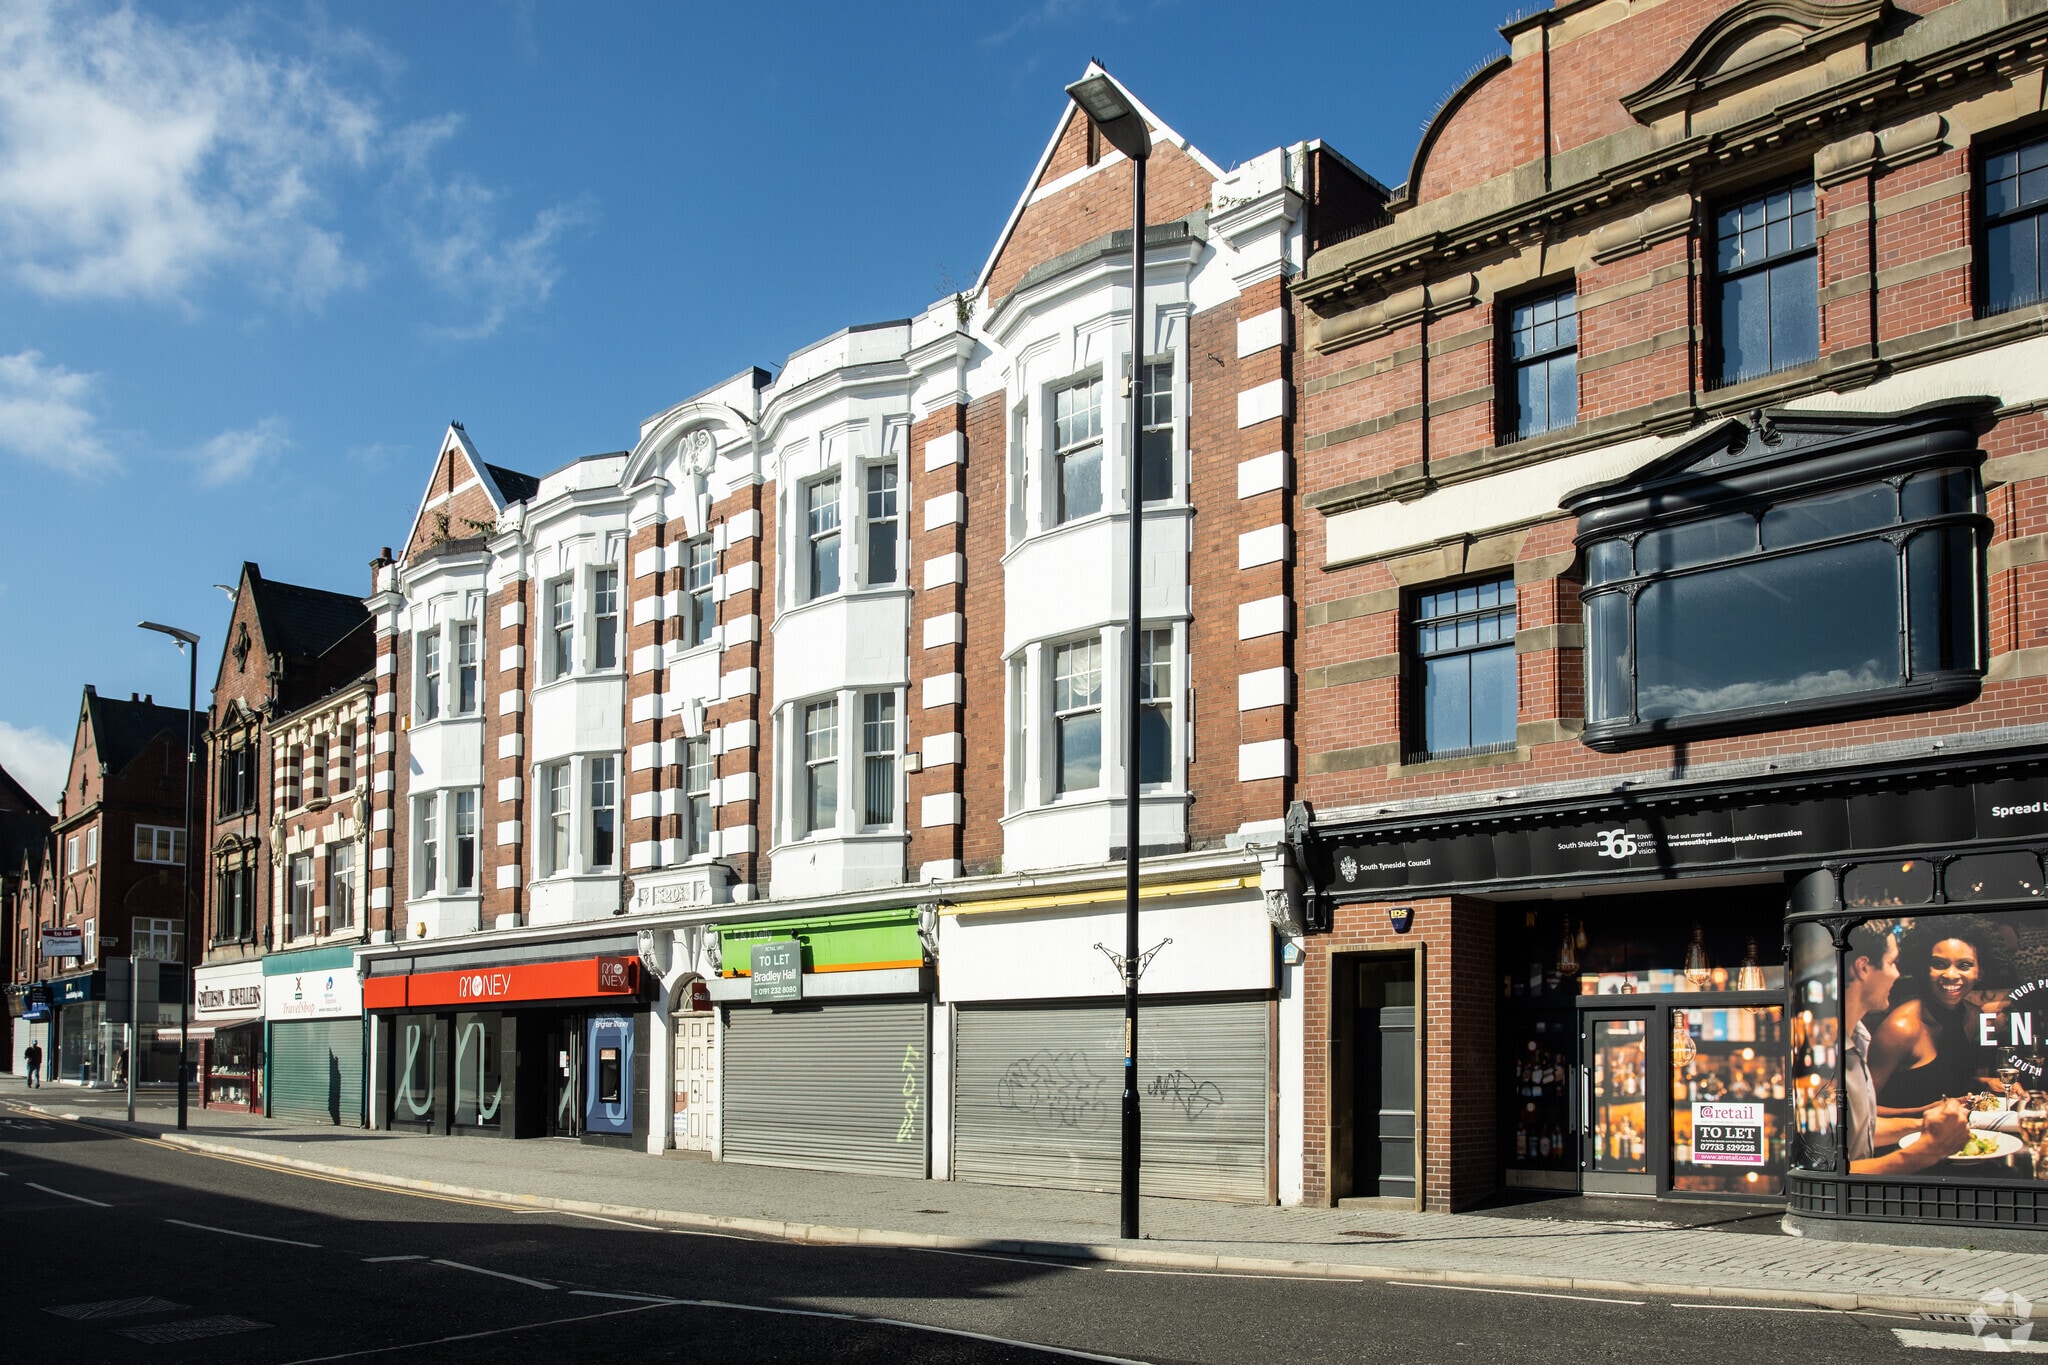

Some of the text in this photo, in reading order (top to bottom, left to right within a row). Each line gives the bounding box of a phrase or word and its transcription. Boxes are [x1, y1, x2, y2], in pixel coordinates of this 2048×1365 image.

[1992, 802, 2041, 818] Spread
[1558, 839, 1600, 850] South Shields
[1597, 829, 1638, 859] 365
[1638, 847, 1657, 855] vision
[1360, 858, 1431, 871] South Tyneside Council
[754, 928, 773, 942] Kelly
[759, 953, 790, 967] TO LET
[754, 968, 796, 984] Bradley Hall
[459, 973, 512, 998] MONEY
[759, 987, 769, 995] 0191
[771, 986, 781, 994] 232
[2008, 981, 2036, 1001] YOUR
[228, 985, 261, 1008] JEWELLERS
[1979, 1012, 2048, 1046] EN
[2008, 1054, 2043, 1077] SOUTH
[1700, 1127, 1755, 1139] TO LET
[1700, 1143, 1756, 1152] 07733 529228
